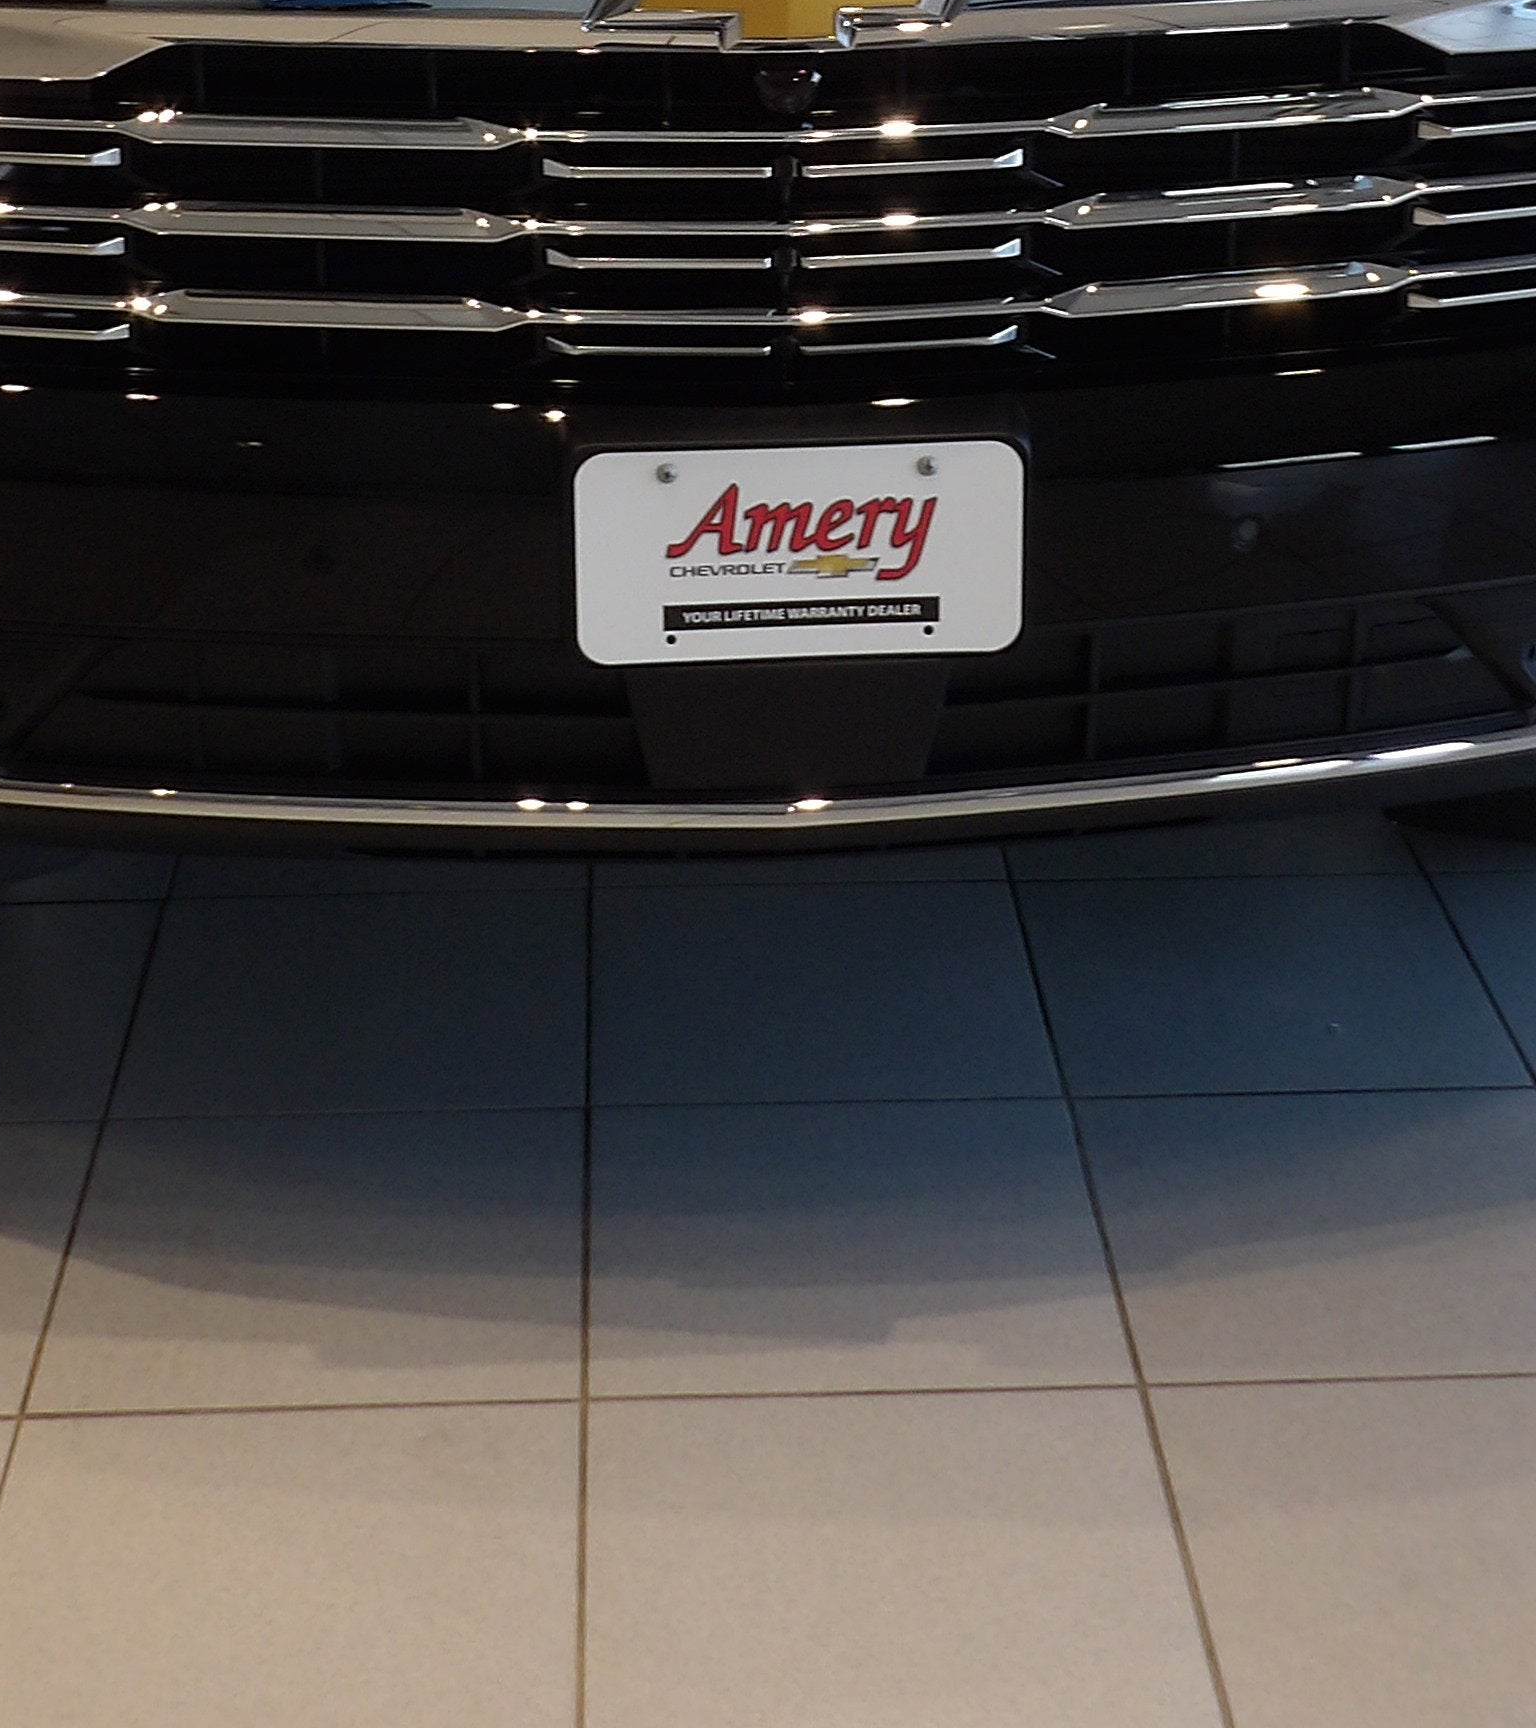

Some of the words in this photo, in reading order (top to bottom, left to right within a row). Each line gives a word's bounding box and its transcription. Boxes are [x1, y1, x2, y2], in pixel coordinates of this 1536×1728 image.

[666, 483, 937, 580] Amery
[669, 562, 786, 577] CHEVROLET
[682, 611, 722, 624] YOUR
[723, 608, 786, 622] LIFETIME
[787, 605, 866, 620] WARRANTY
[867, 603, 923, 618] DEALER
